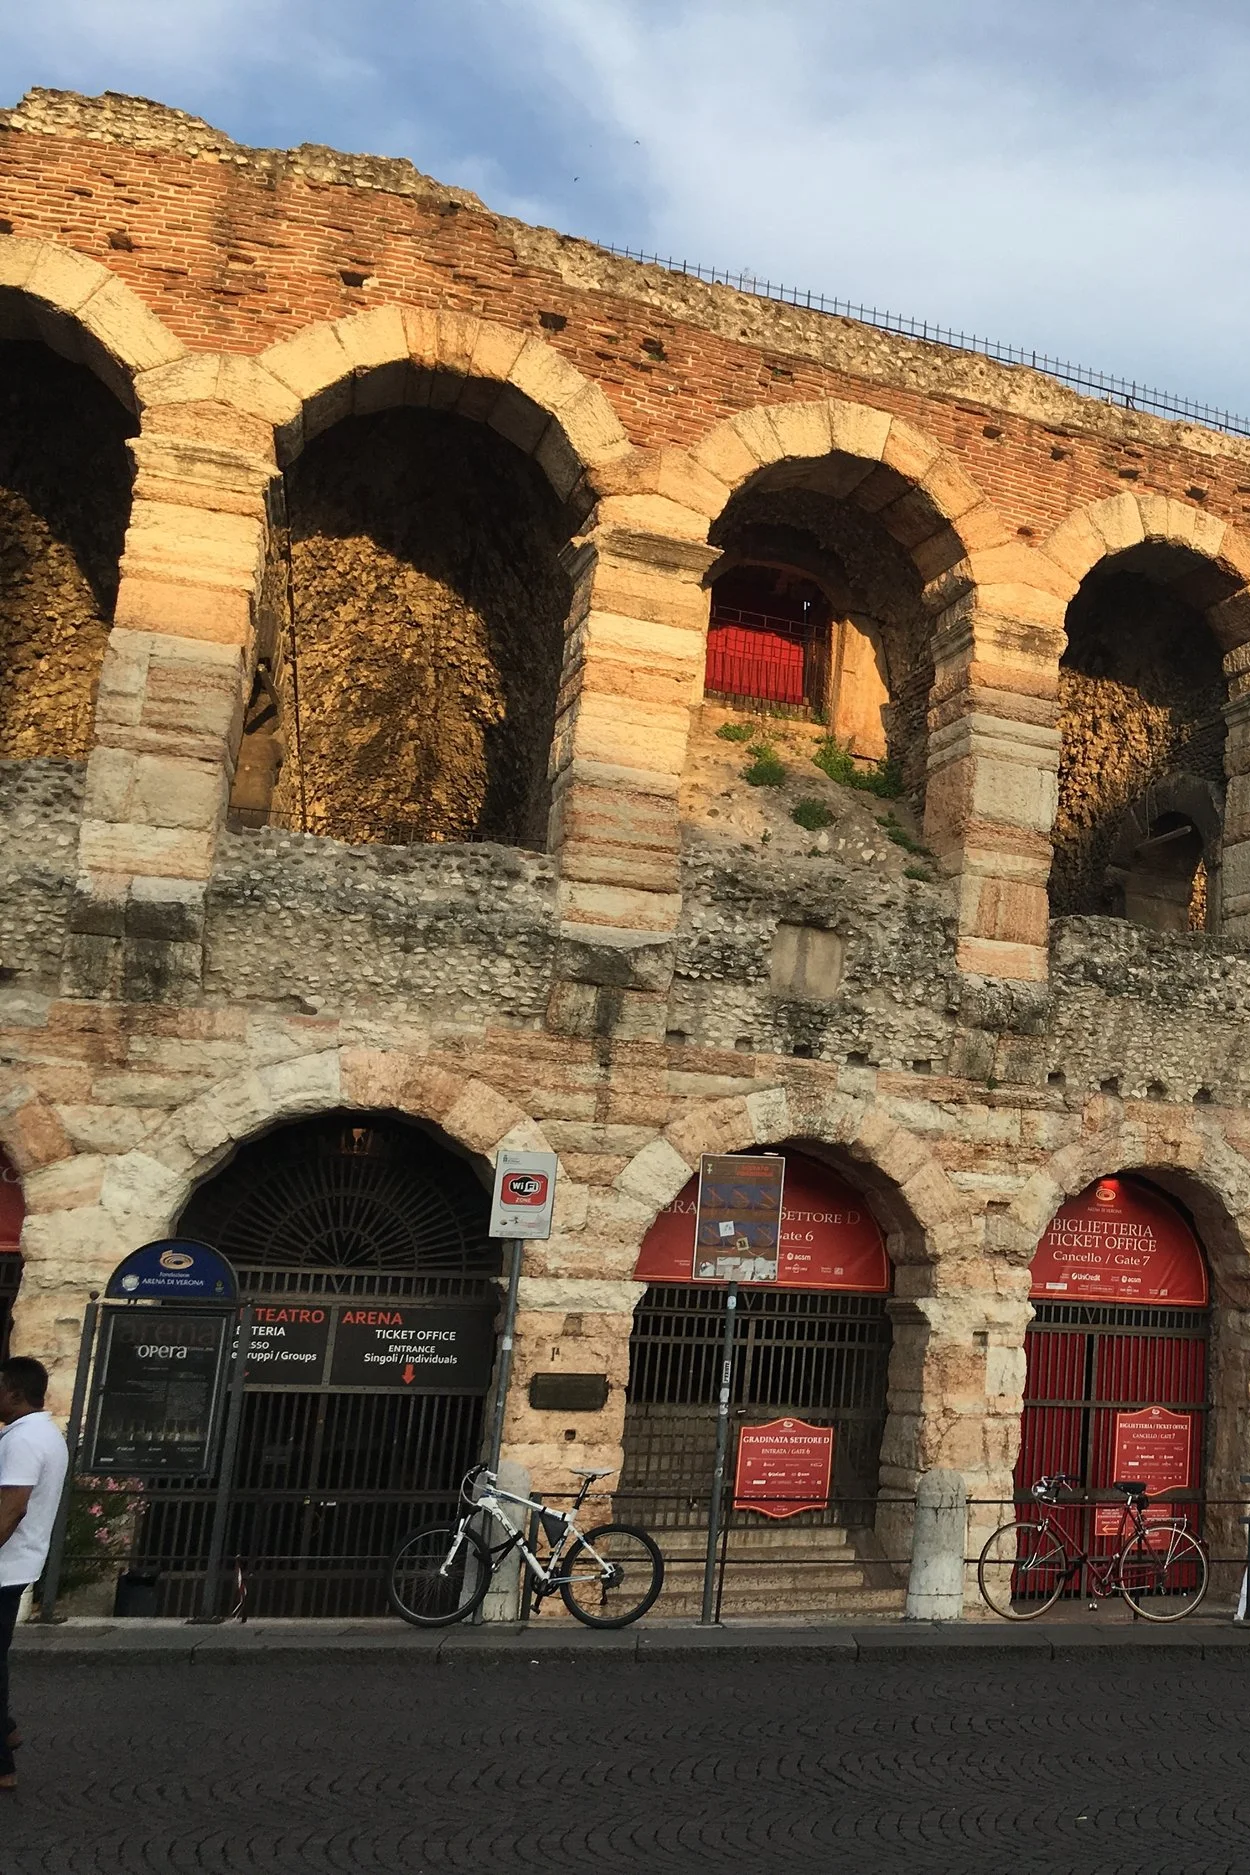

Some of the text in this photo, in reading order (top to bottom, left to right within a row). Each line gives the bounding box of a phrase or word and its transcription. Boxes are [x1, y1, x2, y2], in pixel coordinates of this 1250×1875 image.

[1052, 1218, 1153, 1238] BIGLIETTERIA
[805, 1230, 814, 1242] 6
[1048, 1232, 1157, 1252] TICKET OFFICE
[1053, 1251, 1102, 1263] Cancello
[1114, 1254, 1141, 1266] Gate
[1142, 1255, 1151, 1266] 7
[142, 1277, 165, 1286] ARENA
[176, 1279, 204, 1287] VERONA
[255, 1308, 325, 1324] TEATRO
[342, 1311, 403, 1325] ARENA
[375, 1329, 457, 1341] TICKET OFFICE
[388, 1344, 436, 1354] ENTRANCE
[246, 1350, 274, 1362] ruppi
[281, 1351, 317, 1363] Groups
[364, 1352, 399, 1365] Singoli
[405, 1354, 458, 1364] Individuals
[743, 1435, 788, 1443] GRADINATA
[789, 1436, 822, 1444] SETTORE
